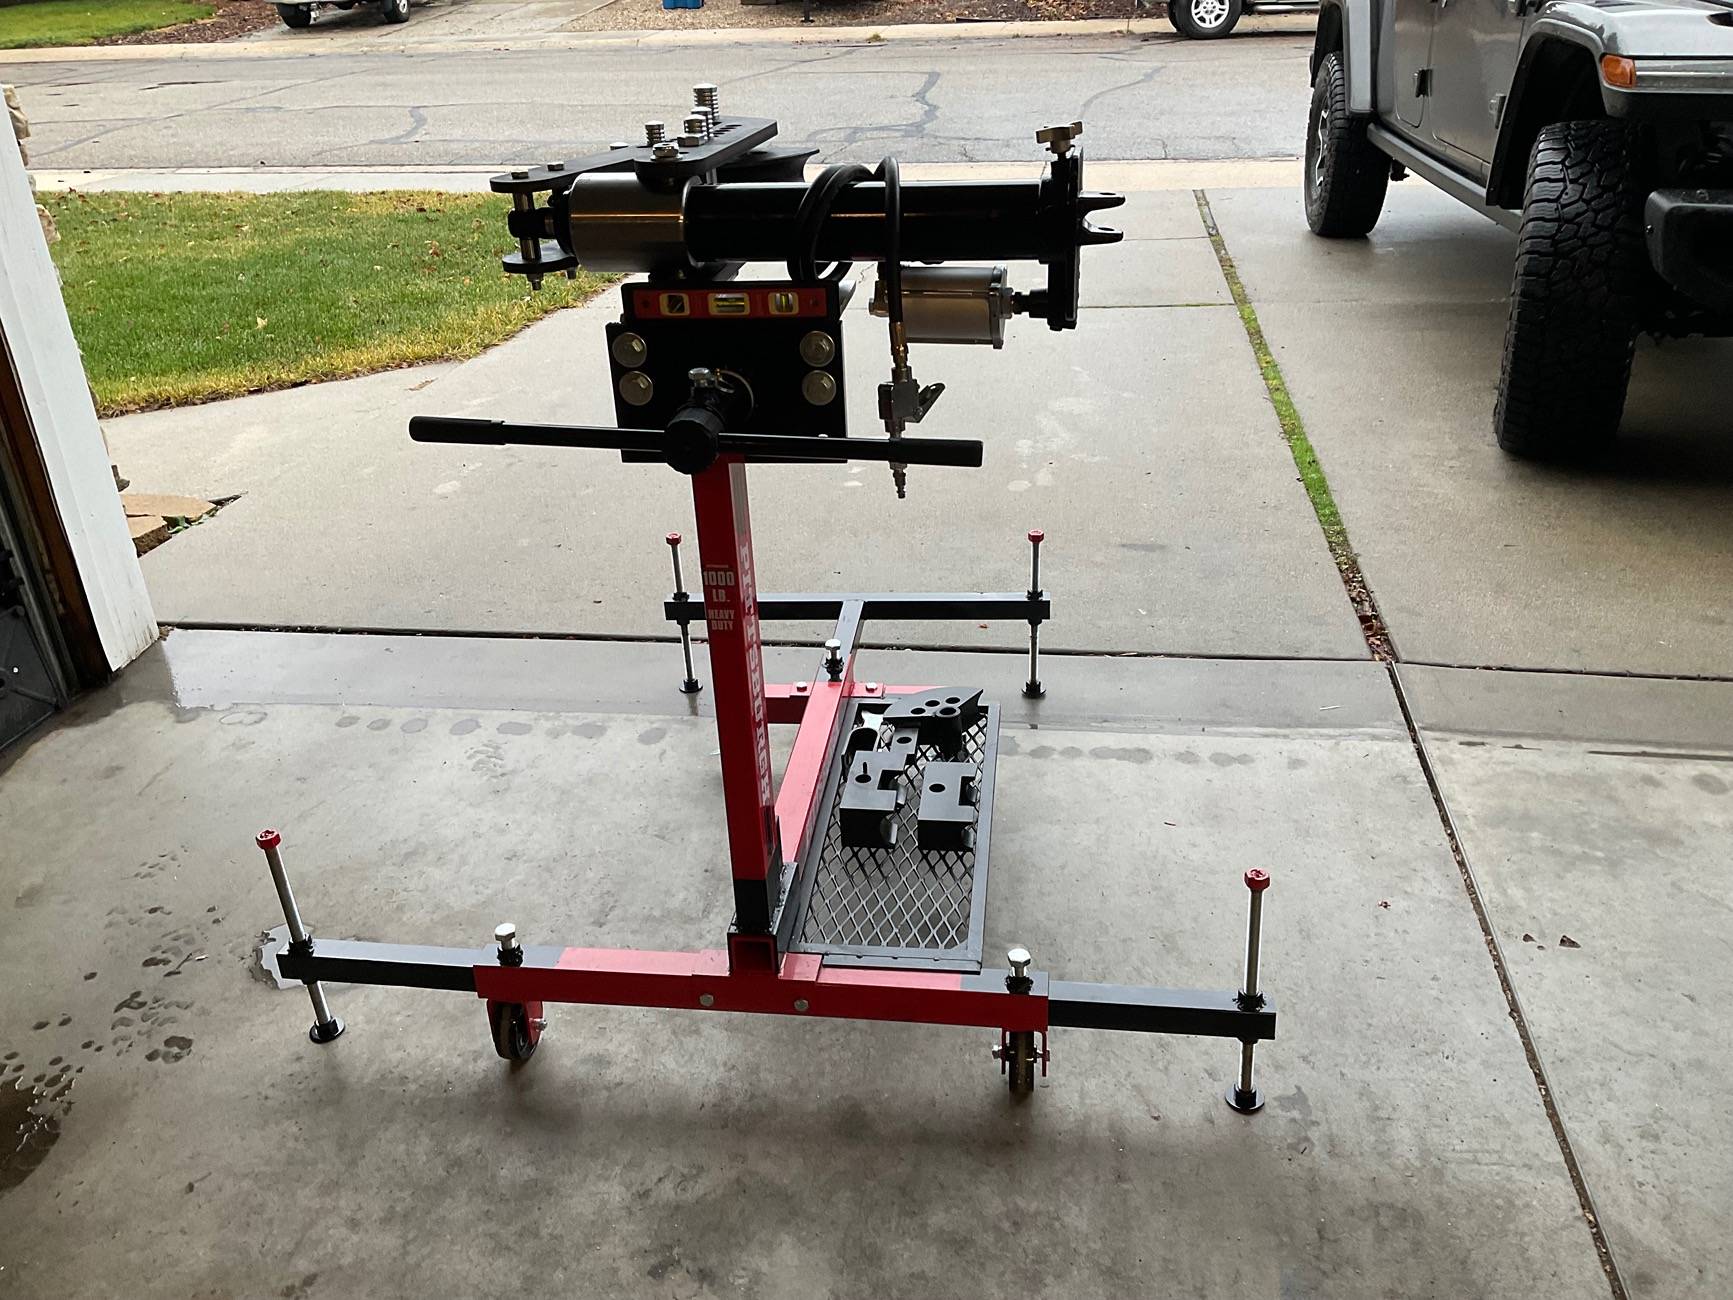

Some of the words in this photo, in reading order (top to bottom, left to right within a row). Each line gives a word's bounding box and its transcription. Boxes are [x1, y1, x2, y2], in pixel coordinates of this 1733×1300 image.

[703, 571, 735, 586] 1000
[708, 609, 735, 620] HEAVY
[711, 620, 734, 631] DUTY
[740, 542, 770, 806] PITTSBURGH
